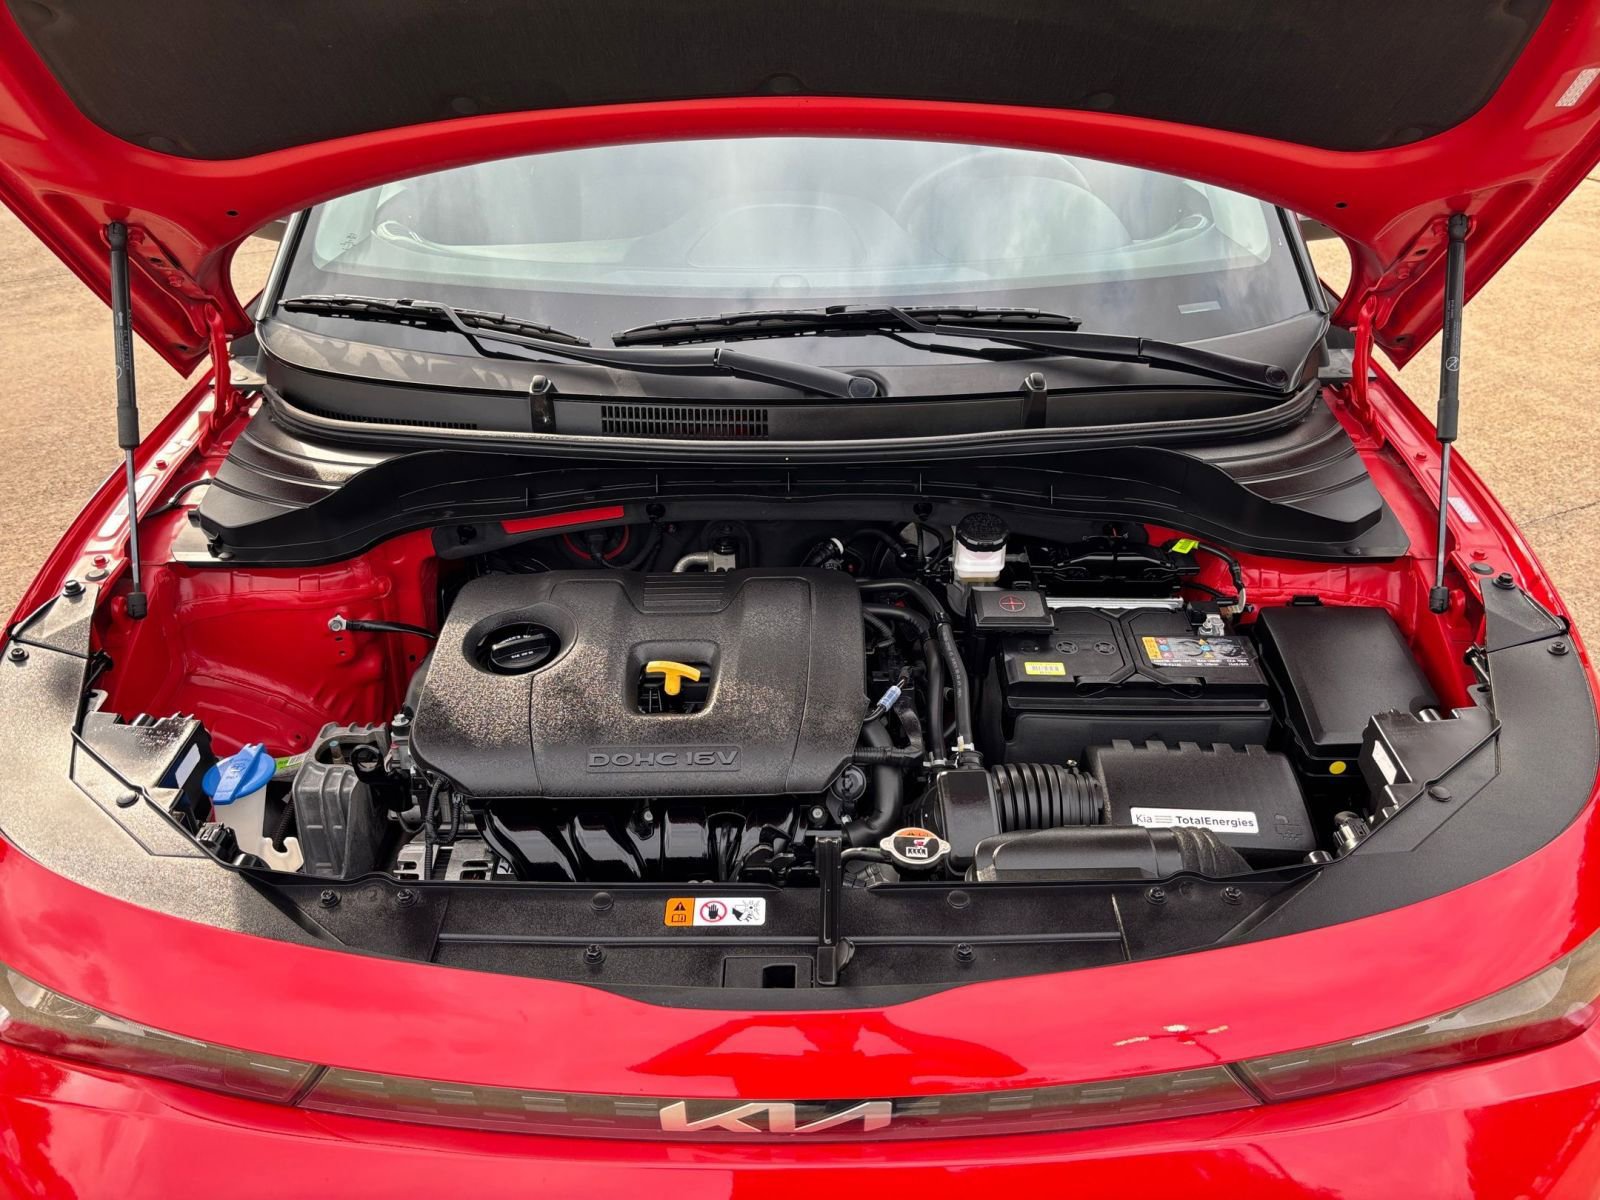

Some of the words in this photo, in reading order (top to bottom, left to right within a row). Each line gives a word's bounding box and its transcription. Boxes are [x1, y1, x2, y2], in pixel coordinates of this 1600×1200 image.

[588, 751, 678, 767] DOHC
[686, 751, 739, 766] 16V
[1135, 814, 1153, 823] Kia
[1175, 815, 1254, 828] TotalEnergies
[659, 1101, 892, 1132] KIA
